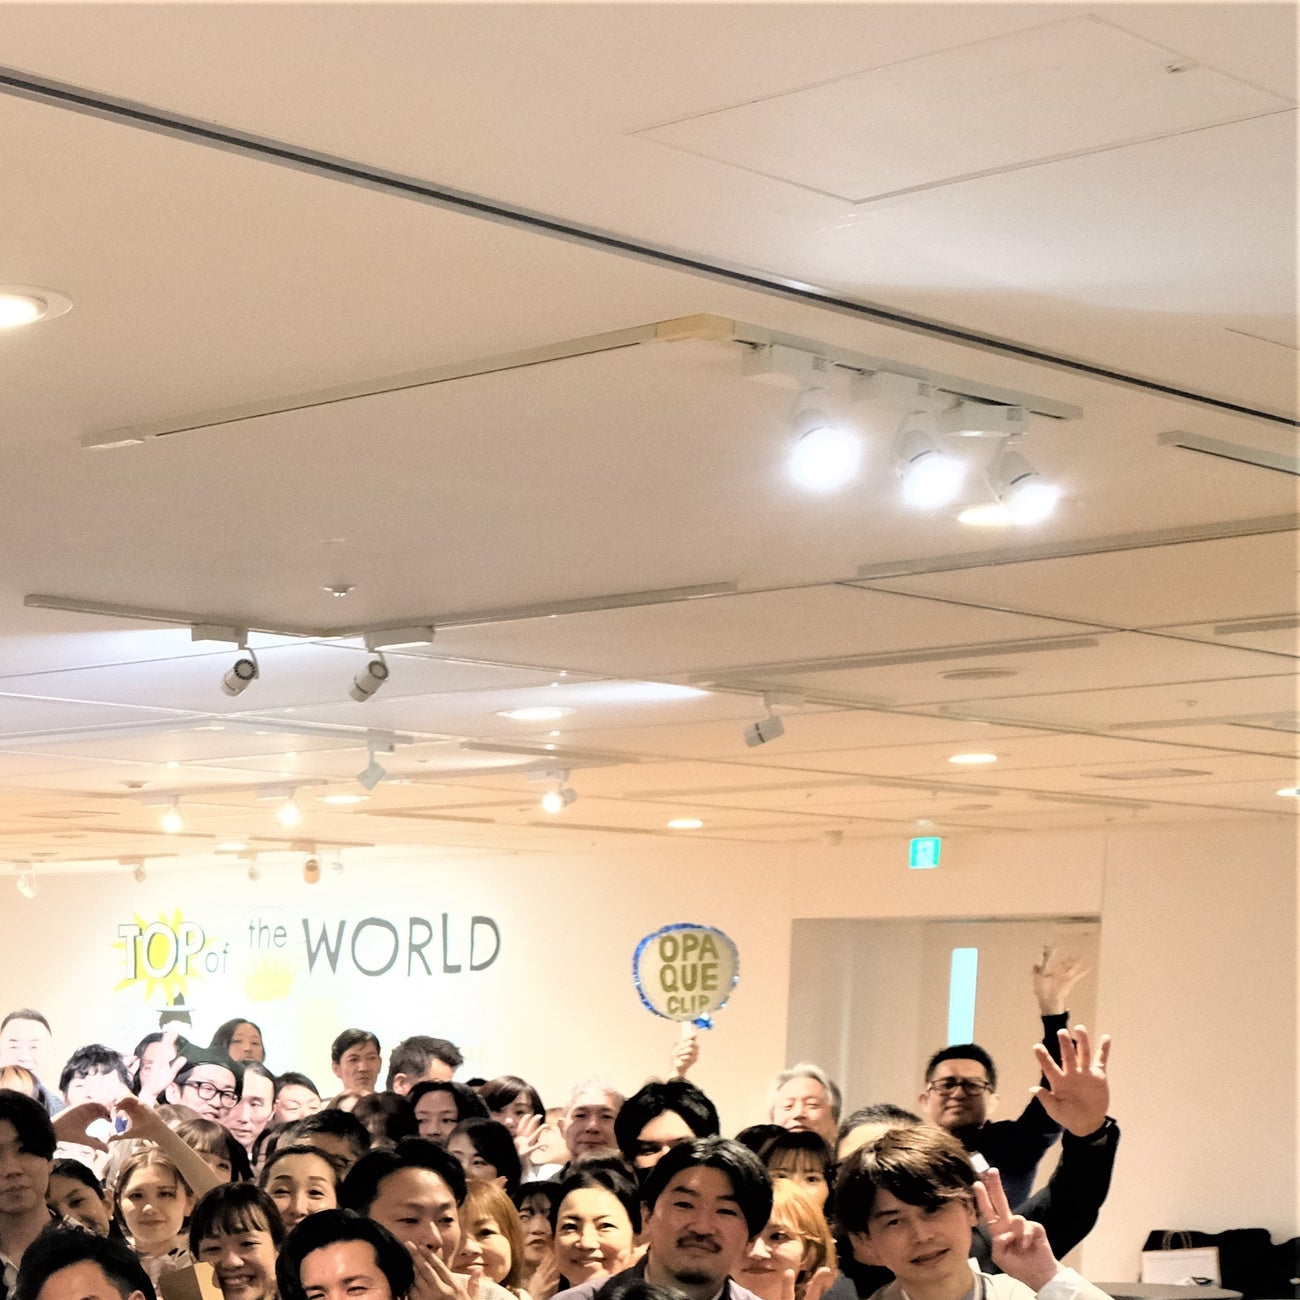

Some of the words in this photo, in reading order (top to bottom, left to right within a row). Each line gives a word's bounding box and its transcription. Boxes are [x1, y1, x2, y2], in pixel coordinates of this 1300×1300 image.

[118, 921, 205, 979] TOP
[205, 943, 231, 974] of
[249, 918, 287, 949] the
[302, 913, 501, 977] WORLD
[659, 934, 719, 963] OPA
[660, 962, 718, 992] QUE
[667, 995, 709, 1014] CLIP
